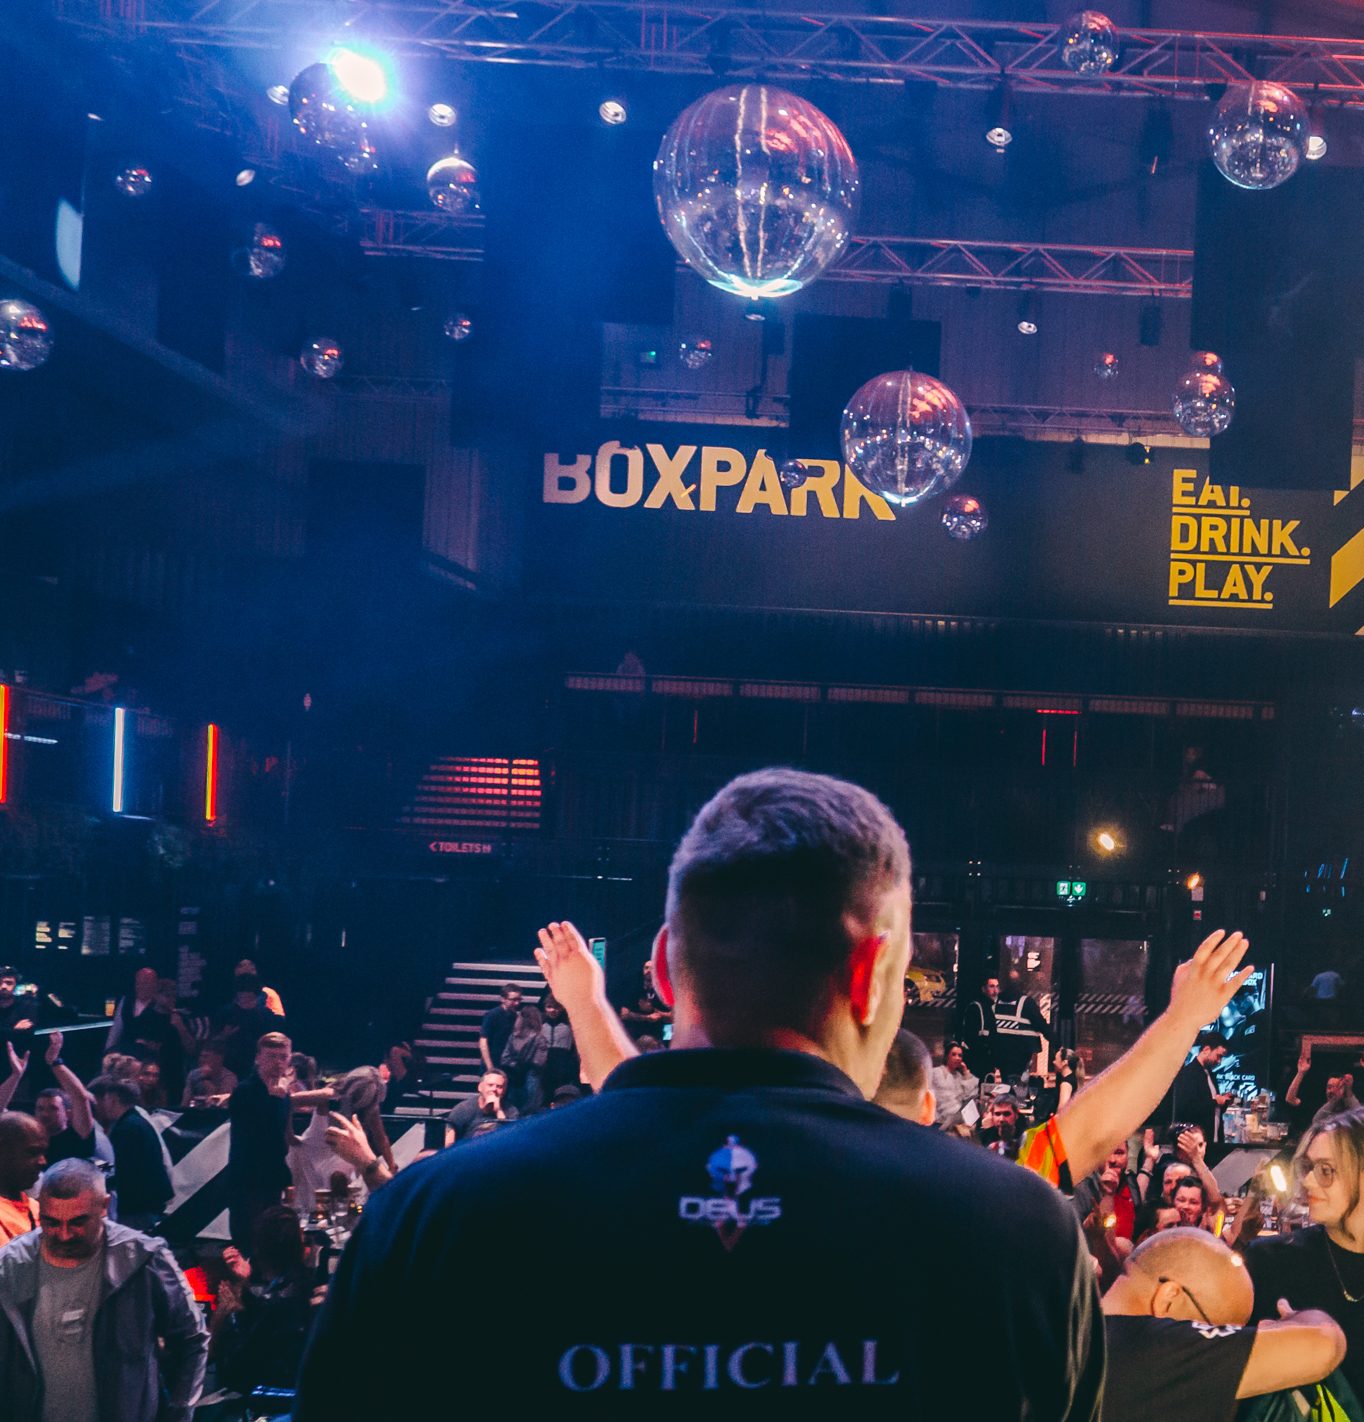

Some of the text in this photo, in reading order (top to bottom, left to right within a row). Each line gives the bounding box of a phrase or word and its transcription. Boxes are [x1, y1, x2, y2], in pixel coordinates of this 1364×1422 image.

[1170, 515, 1311, 557] DRINK.
[1168, 561, 1274, 602] PLAY.
[679, 1196, 782, 1220] DEUS
[557, 1339, 901, 1392] OFFICIAL
